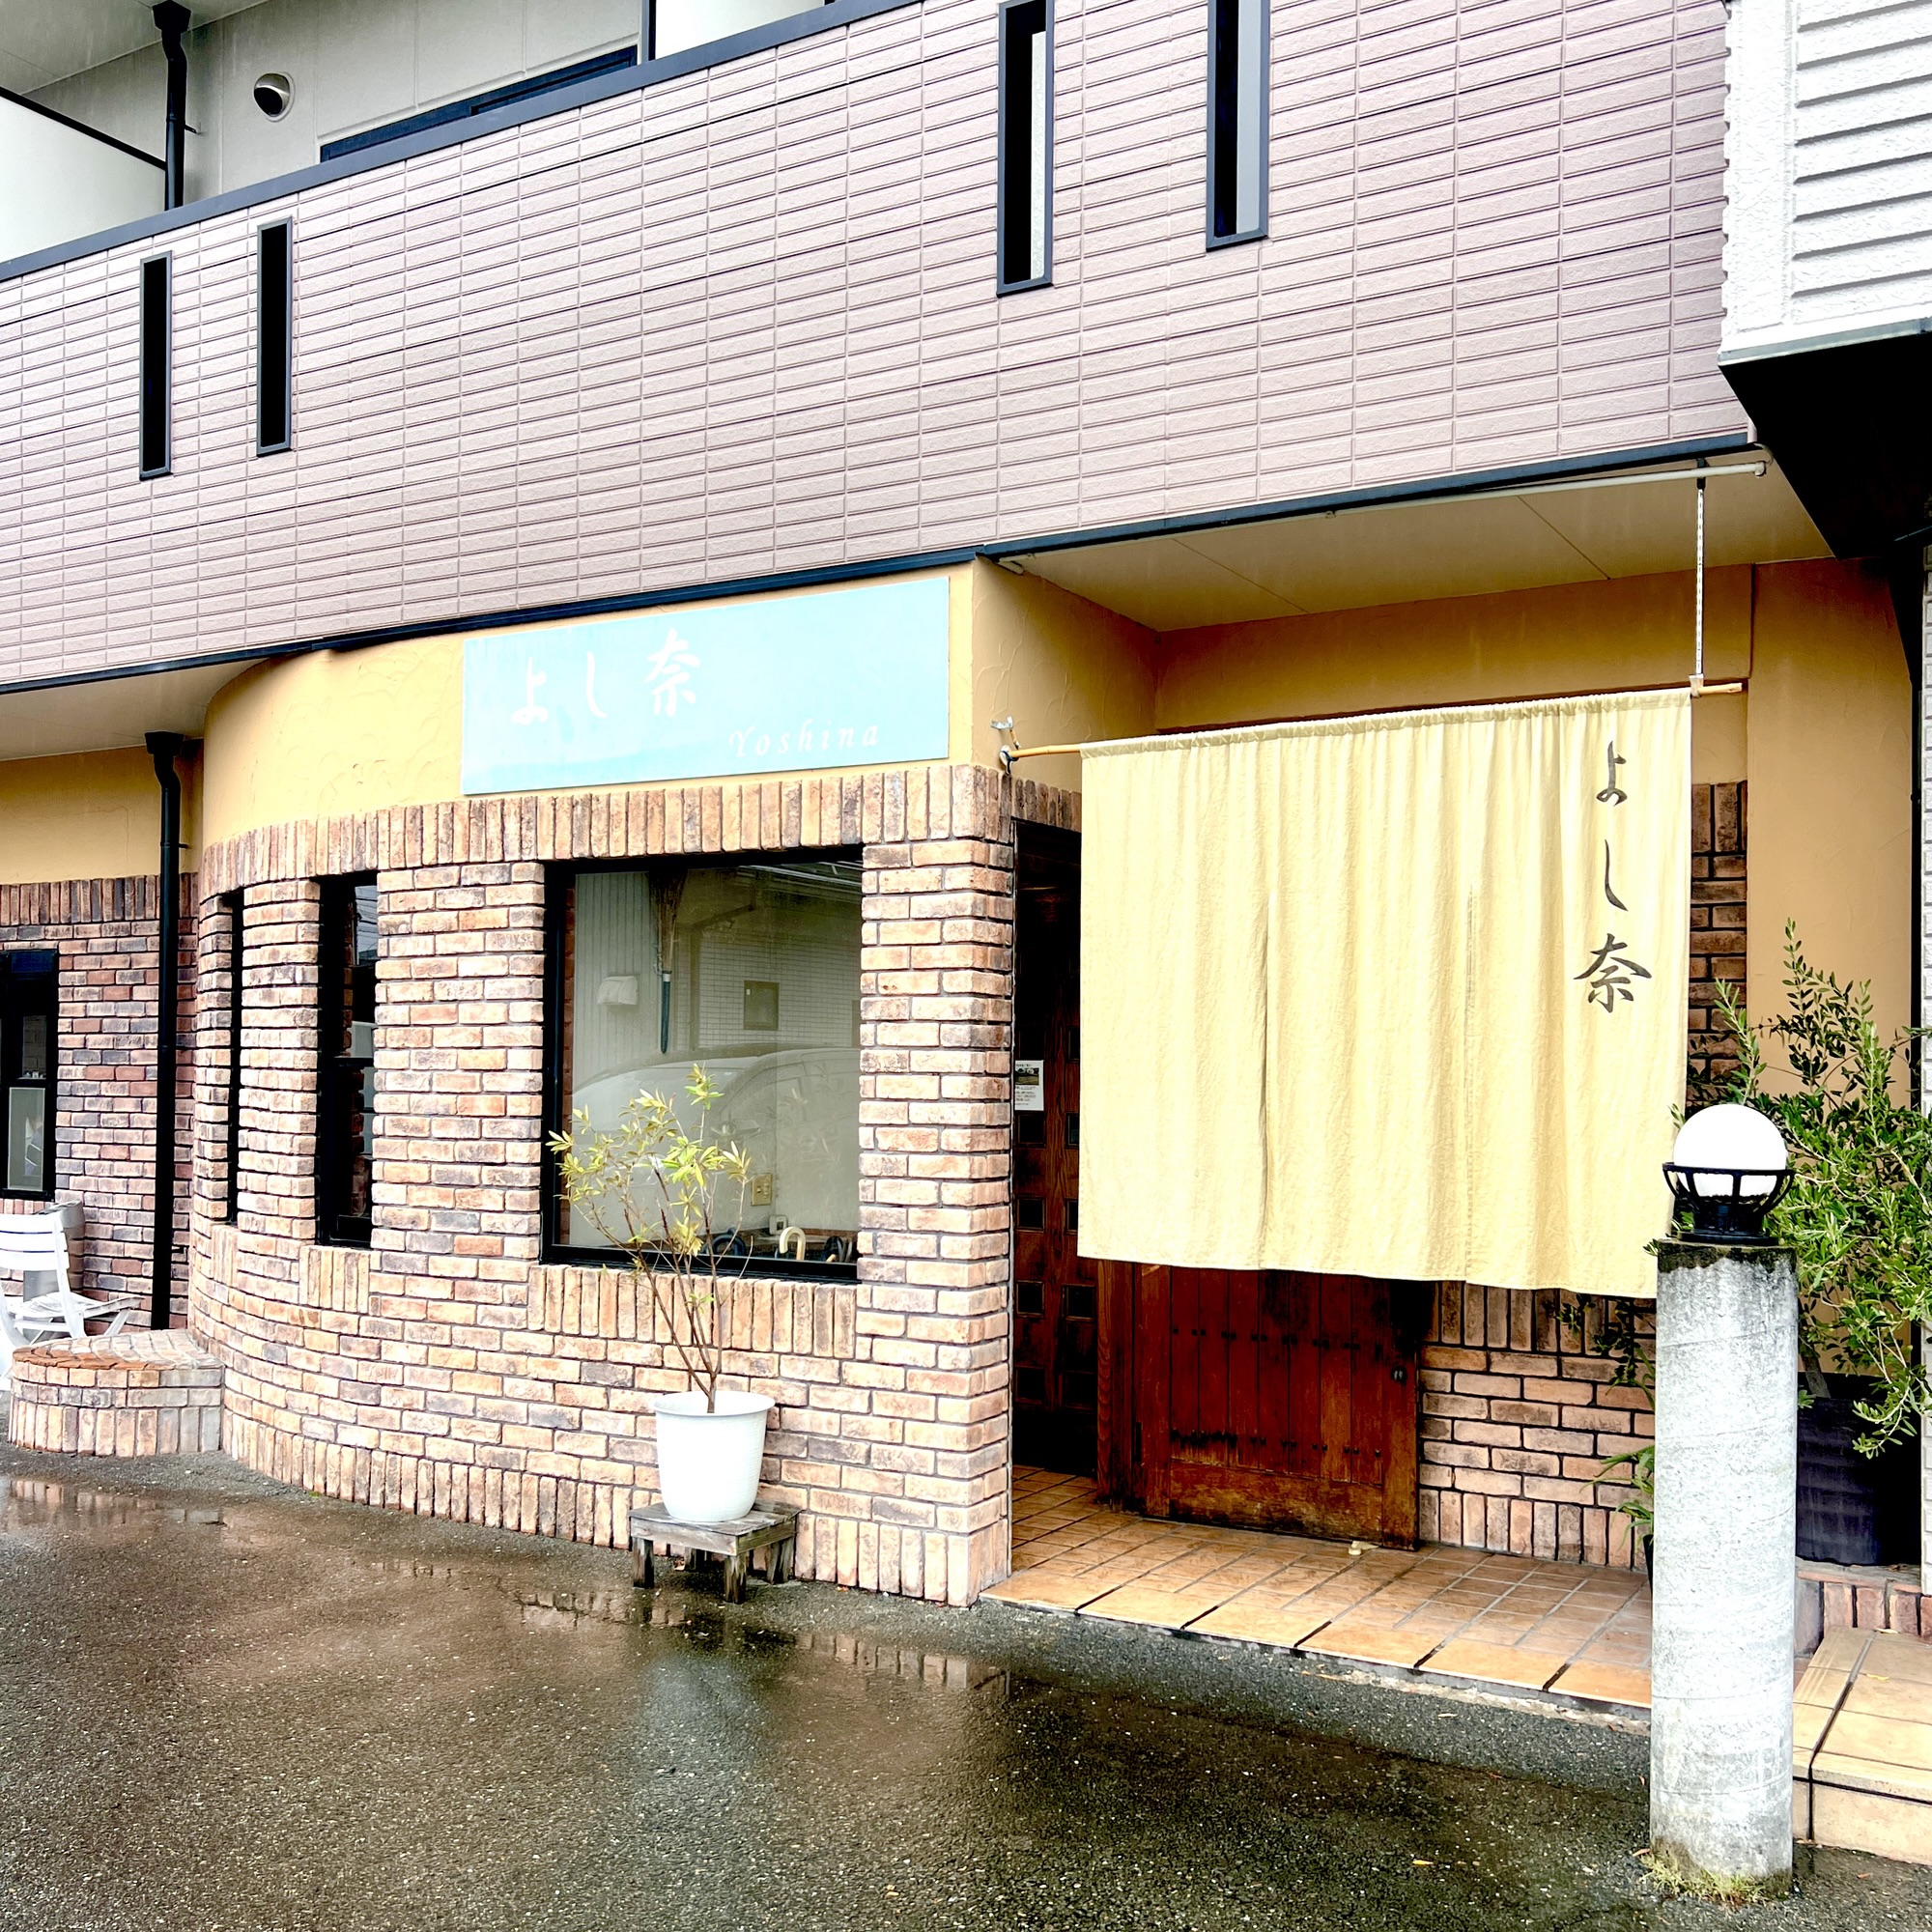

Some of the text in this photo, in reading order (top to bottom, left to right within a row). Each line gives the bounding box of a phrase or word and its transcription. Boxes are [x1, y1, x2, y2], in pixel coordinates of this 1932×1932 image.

[512, 628, 700, 724] よし奈
[729, 719, 880, 758] Yoshina
[1574, 740, 1652, 1013] よし奈
